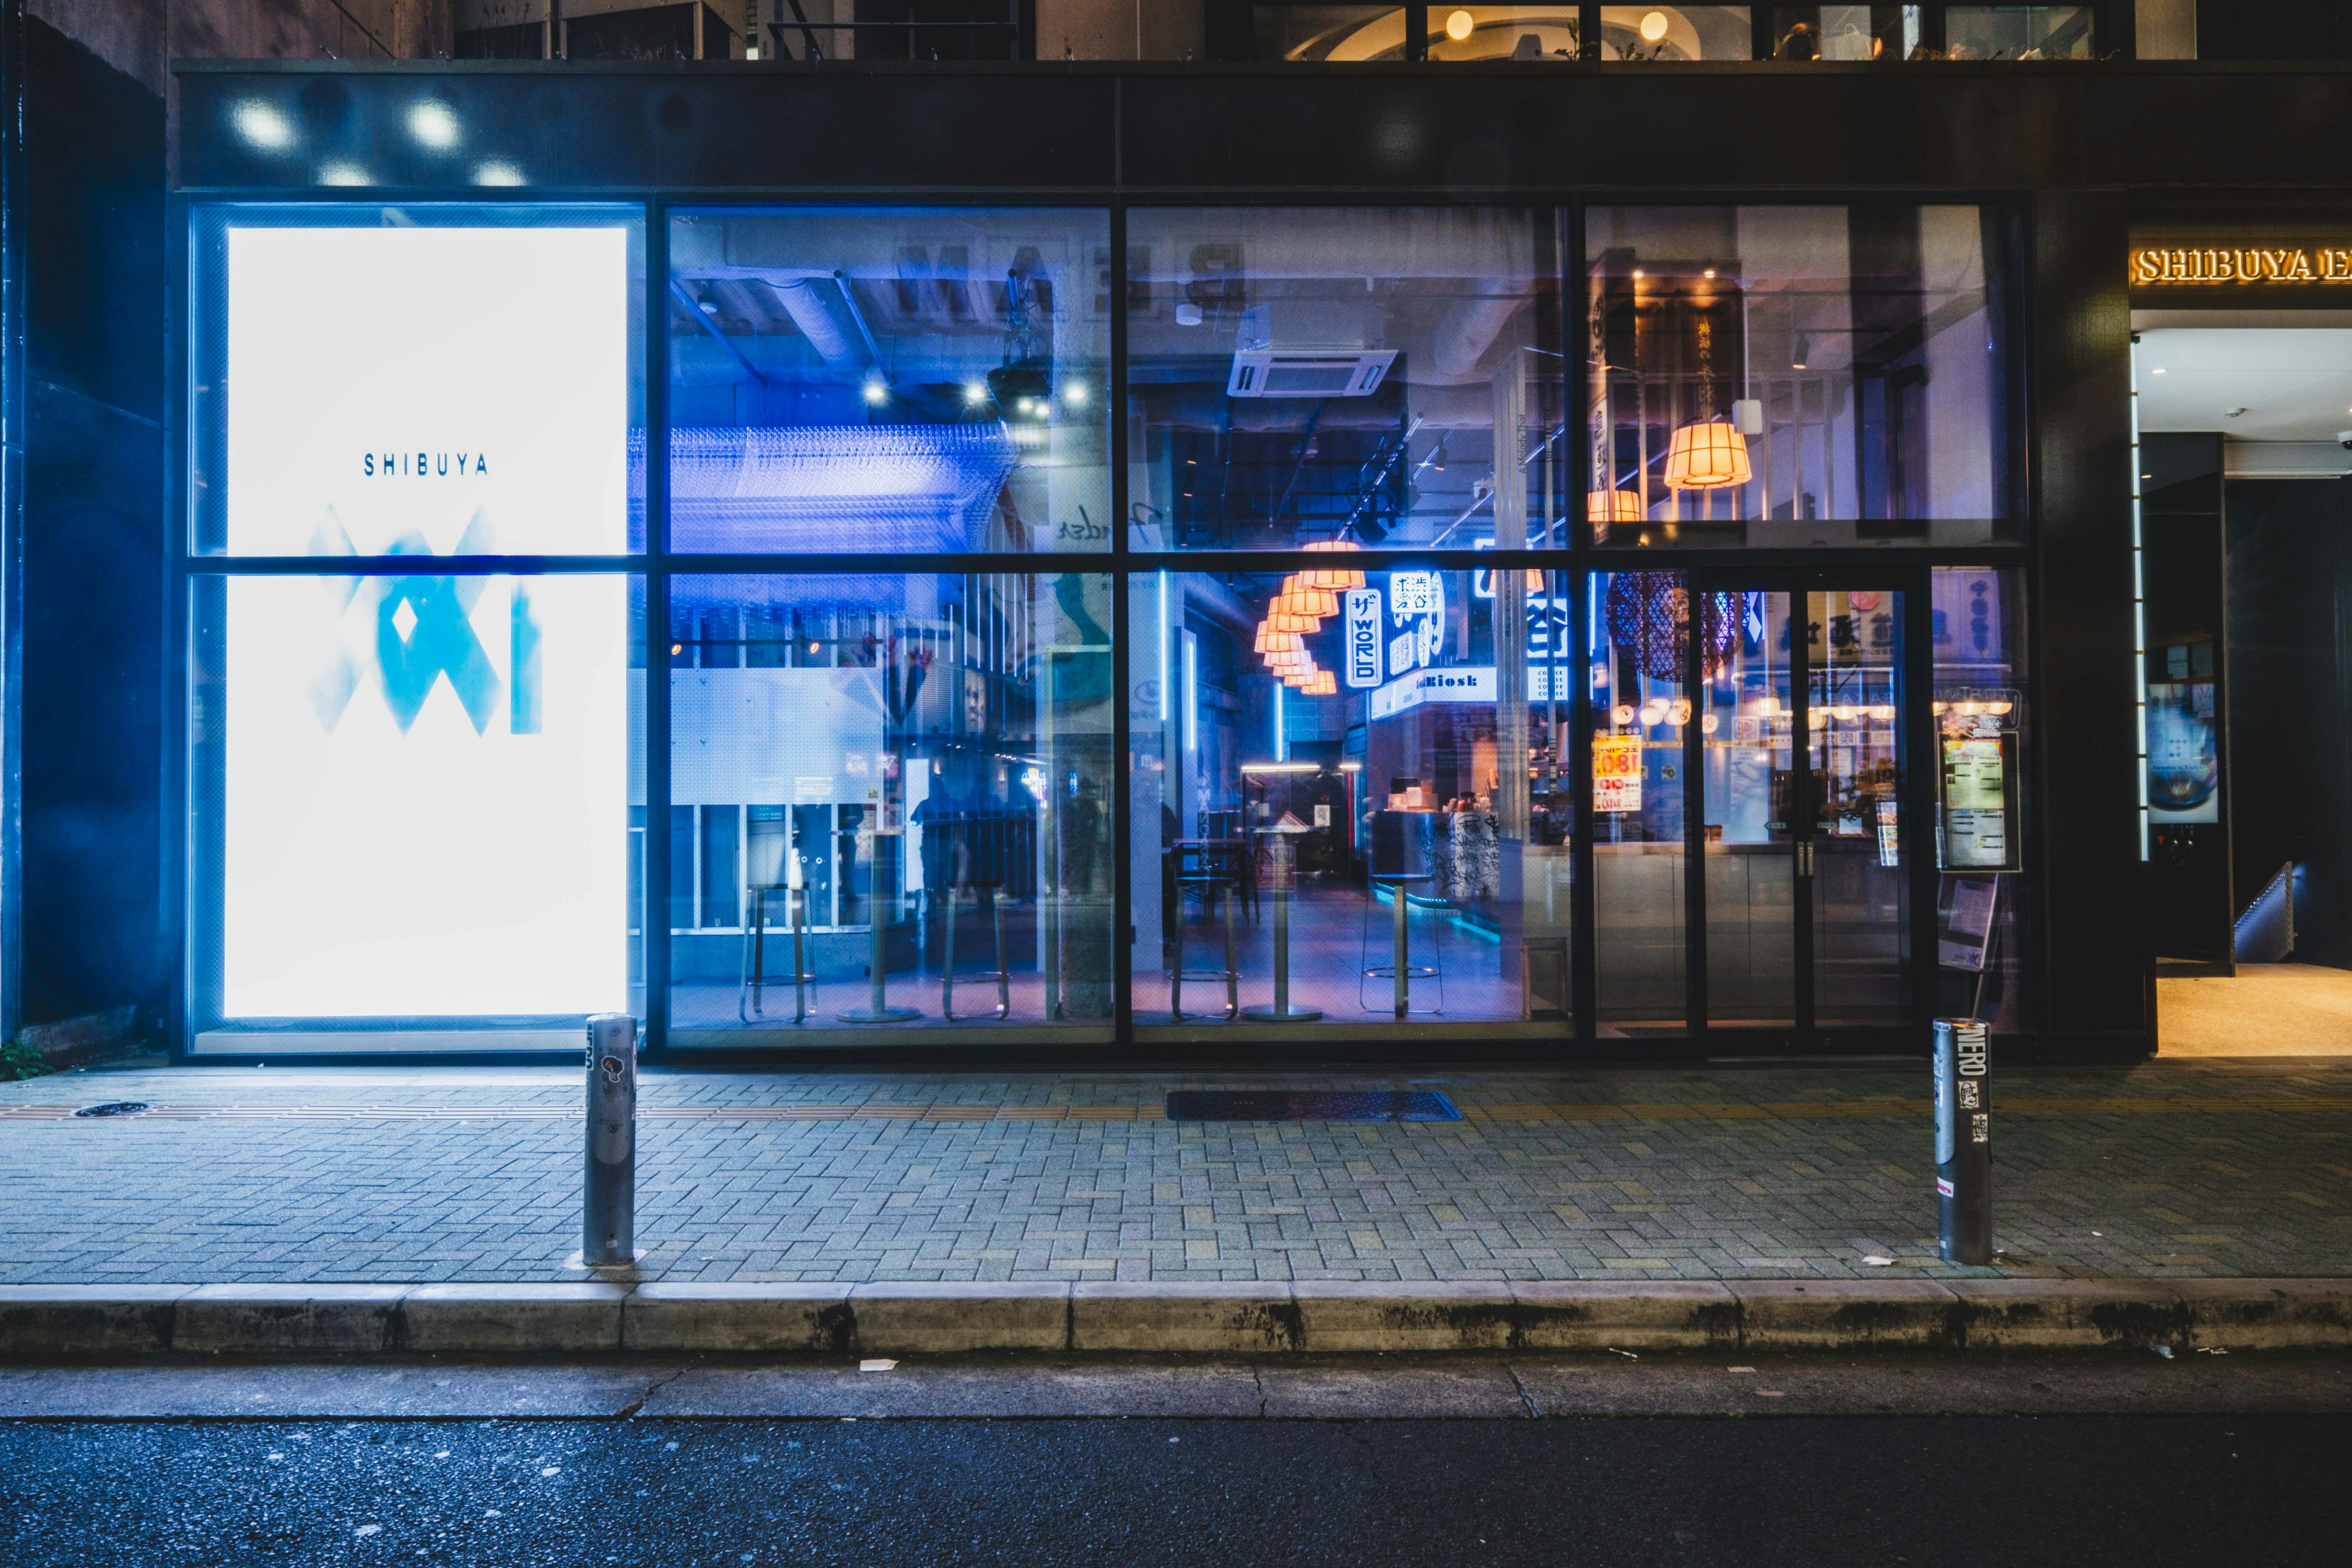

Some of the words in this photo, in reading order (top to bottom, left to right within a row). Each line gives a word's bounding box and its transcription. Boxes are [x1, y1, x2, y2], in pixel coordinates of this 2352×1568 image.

[2138, 249, 2318, 281] SHIBUYA
[2324, 249, 2352, 281] E
[364, 453, 488, 476] SHIBUYA
[1352, 594, 1376, 616] ザ
[1354, 620, 1375, 678] WORLD
[1957, 1028, 1986, 1076] NERO
